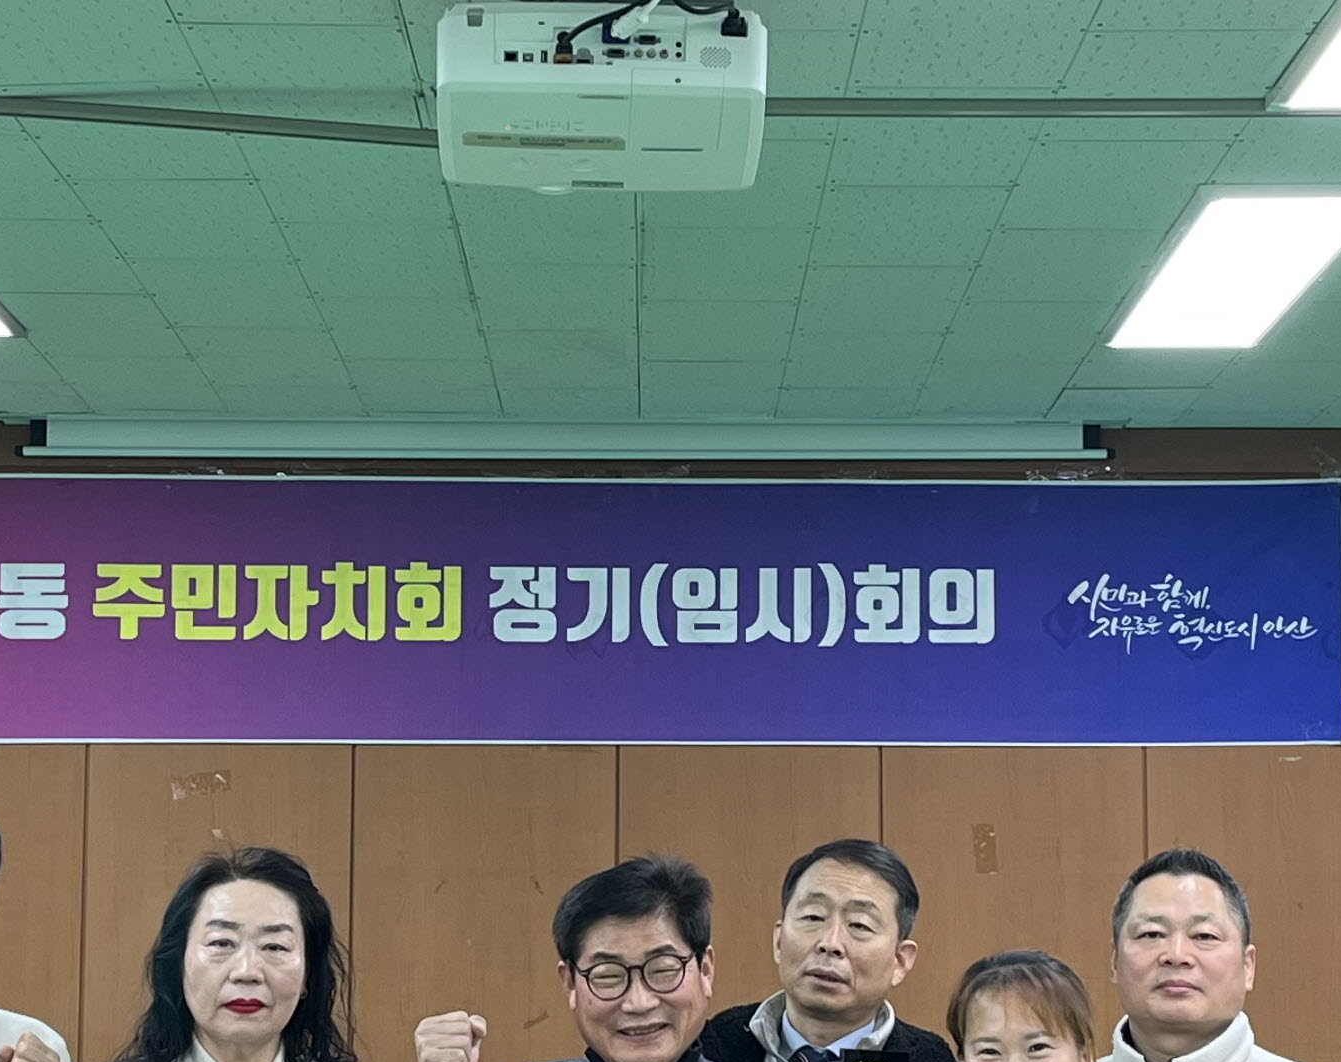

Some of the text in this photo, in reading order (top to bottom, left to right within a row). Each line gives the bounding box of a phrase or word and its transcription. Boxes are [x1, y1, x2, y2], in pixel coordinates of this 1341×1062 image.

[92, 561, 462, 642] 주민자치회
[488, 562, 996, 648] 정기(임시)회의
[1067, 573, 1154, 622] 시민과
[1088, 612, 1318, 655] 자유로운 혁신도시 안산
